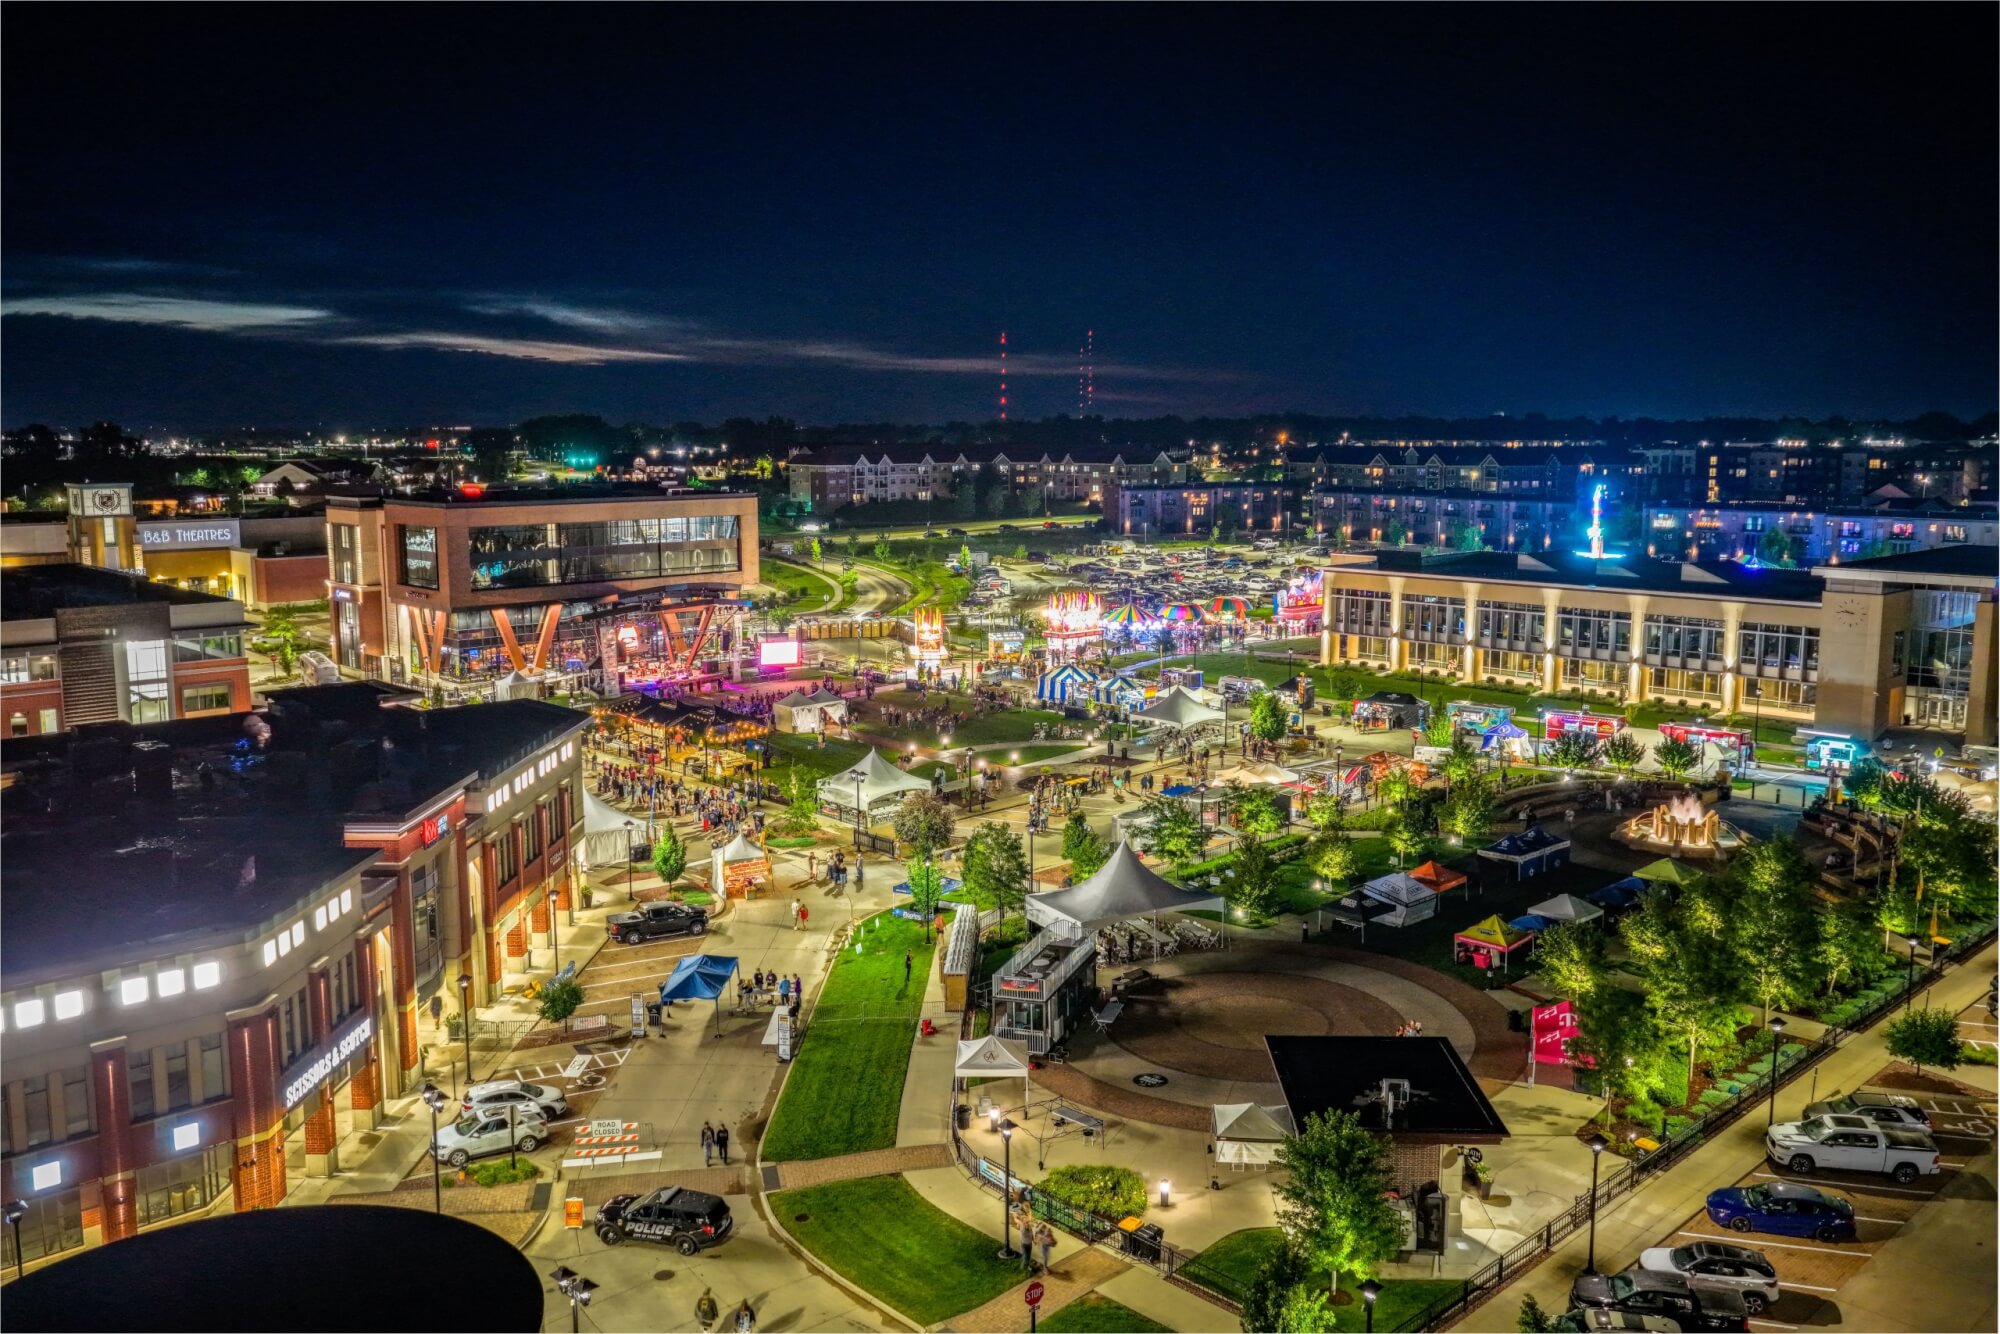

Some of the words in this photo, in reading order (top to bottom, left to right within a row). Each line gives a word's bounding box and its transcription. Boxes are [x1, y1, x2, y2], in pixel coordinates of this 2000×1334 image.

[144, 530, 170, 543] B&B
[176, 529, 231, 542] THEATRES
[286, 1052, 332, 1108] SCISSORS
[332, 1046, 340, 1067] &
[340, 1017, 371, 1060] SCOTCH
[594, 1128, 621, 1136] CLOSED
[625, 1221, 674, 1236] POLICE
[1026, 1287, 1043, 1301] STOP
